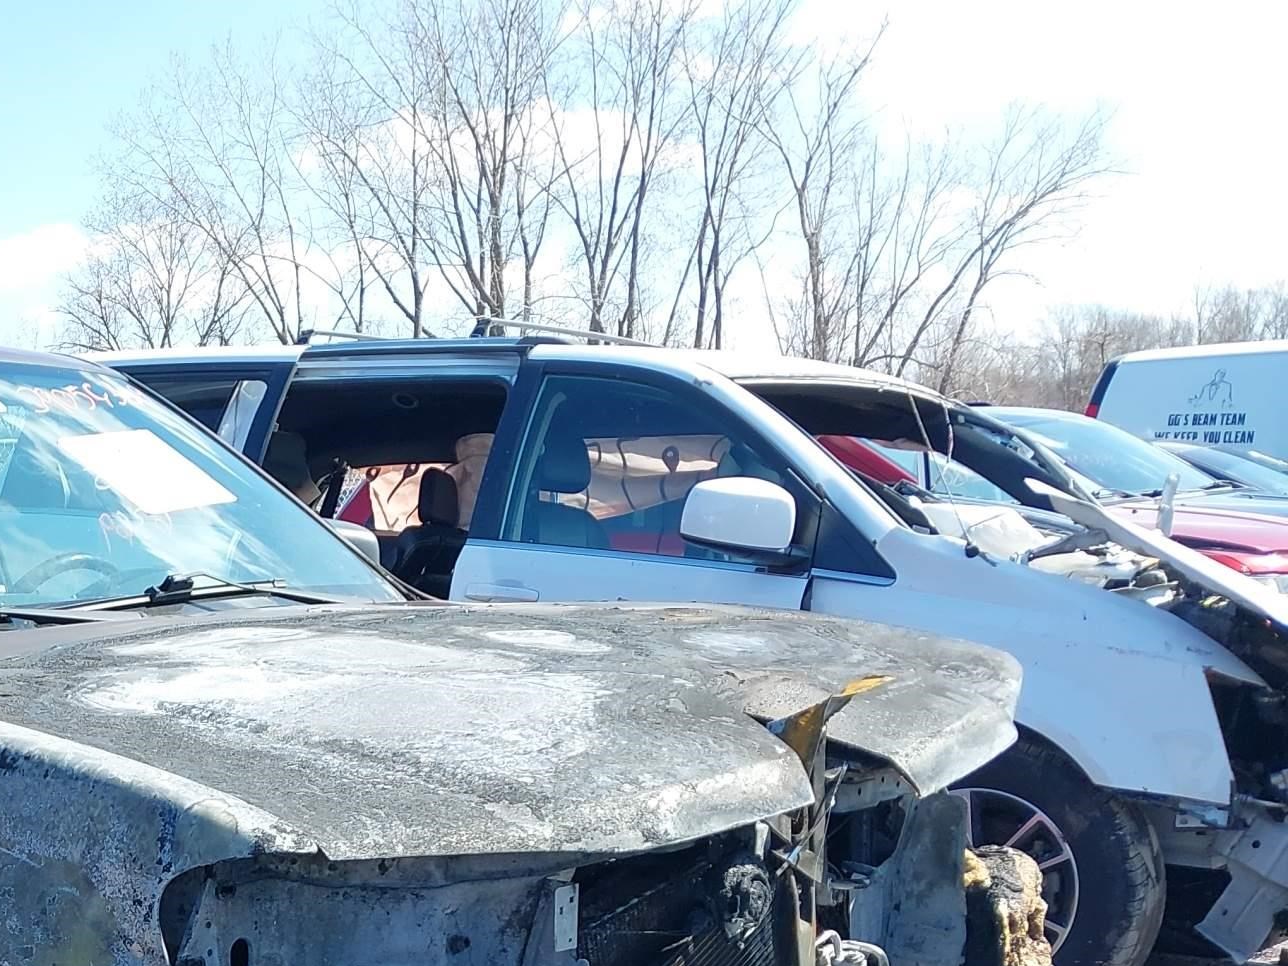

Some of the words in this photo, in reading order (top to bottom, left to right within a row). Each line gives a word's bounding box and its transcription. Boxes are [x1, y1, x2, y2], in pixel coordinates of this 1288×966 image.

[1220, 412, 1247, 426] TEAM
[1203, 431, 1221, 444] YOU
[1223, 430, 1256, 444] CLEAN
